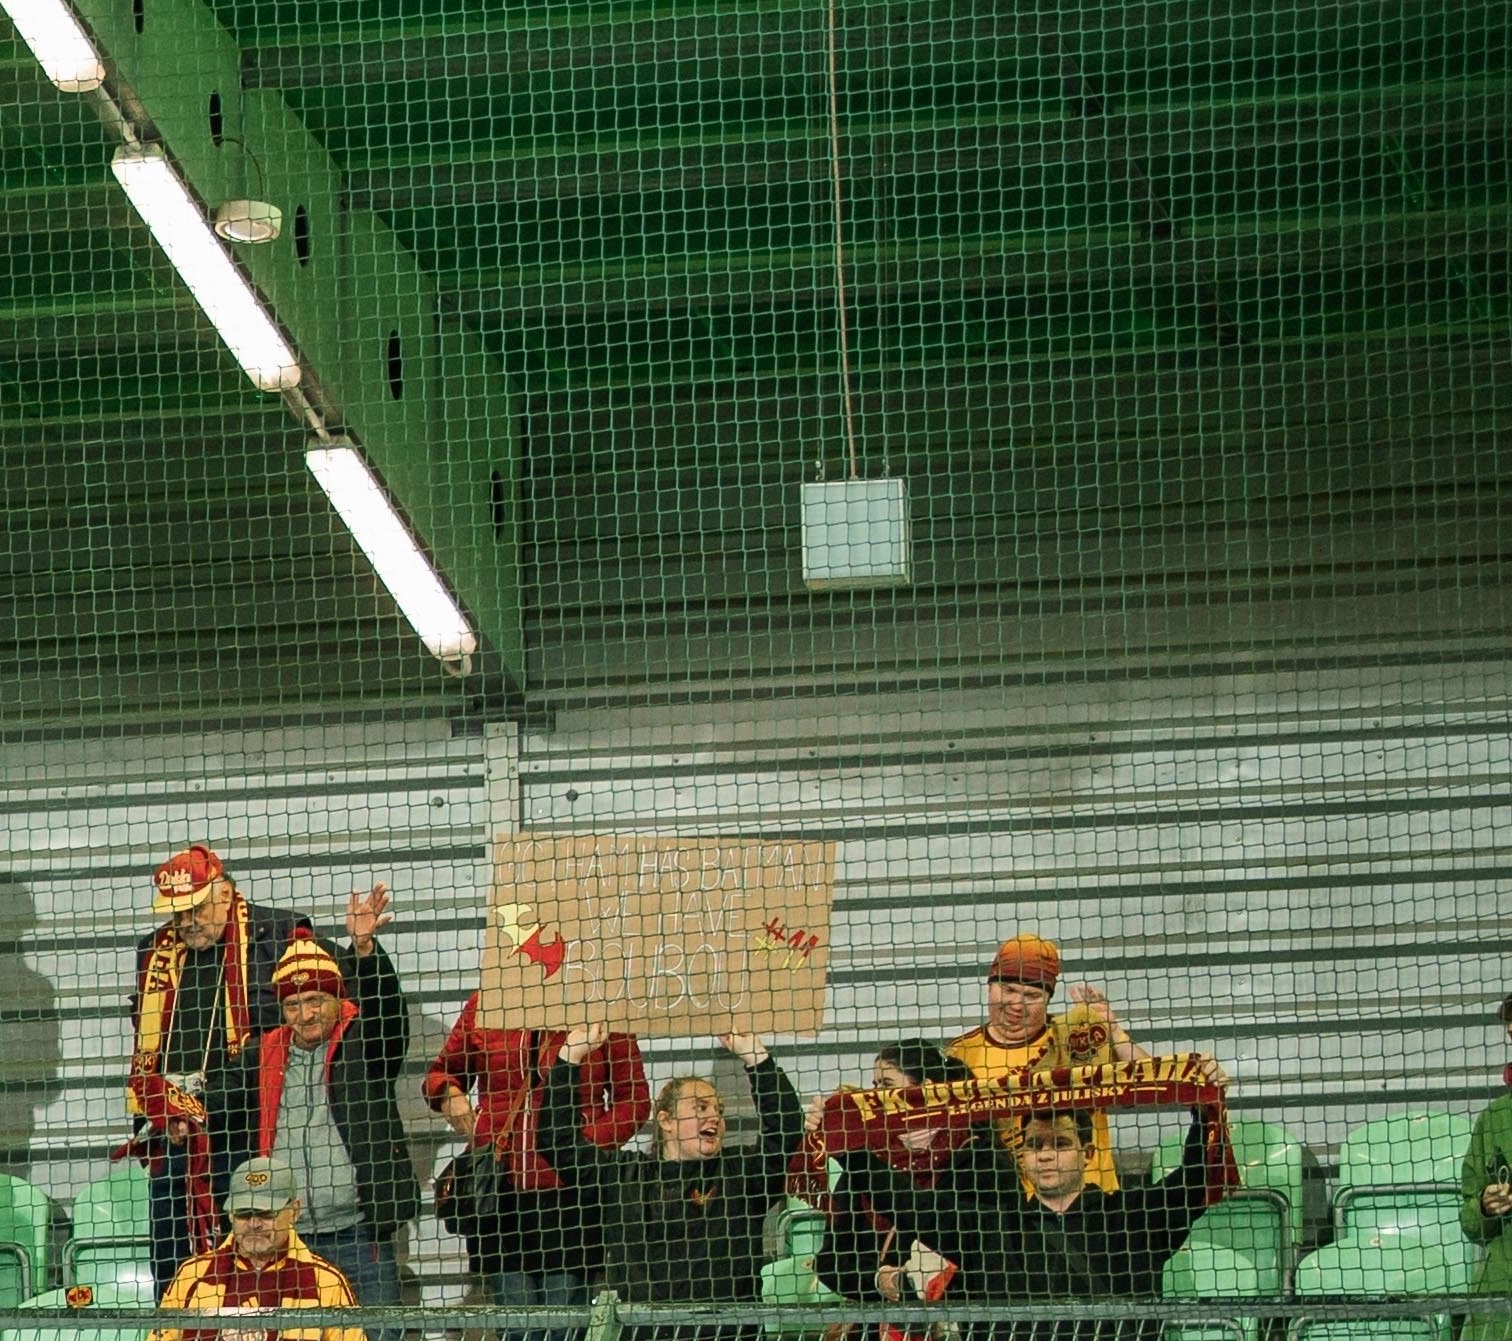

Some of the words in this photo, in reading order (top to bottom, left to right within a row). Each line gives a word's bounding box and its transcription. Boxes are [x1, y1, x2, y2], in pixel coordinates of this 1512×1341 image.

[640, 844, 690, 889] HAS
[702, 842, 824, 891] BATMAN
[586, 891, 641, 936] WE
[657, 893, 751, 938] HAVE
[564, 941, 749, 1010] BOUBOU
[852, 1087, 914, 1122] FK
[1052, 1085, 1127, 1103] JULISKY
